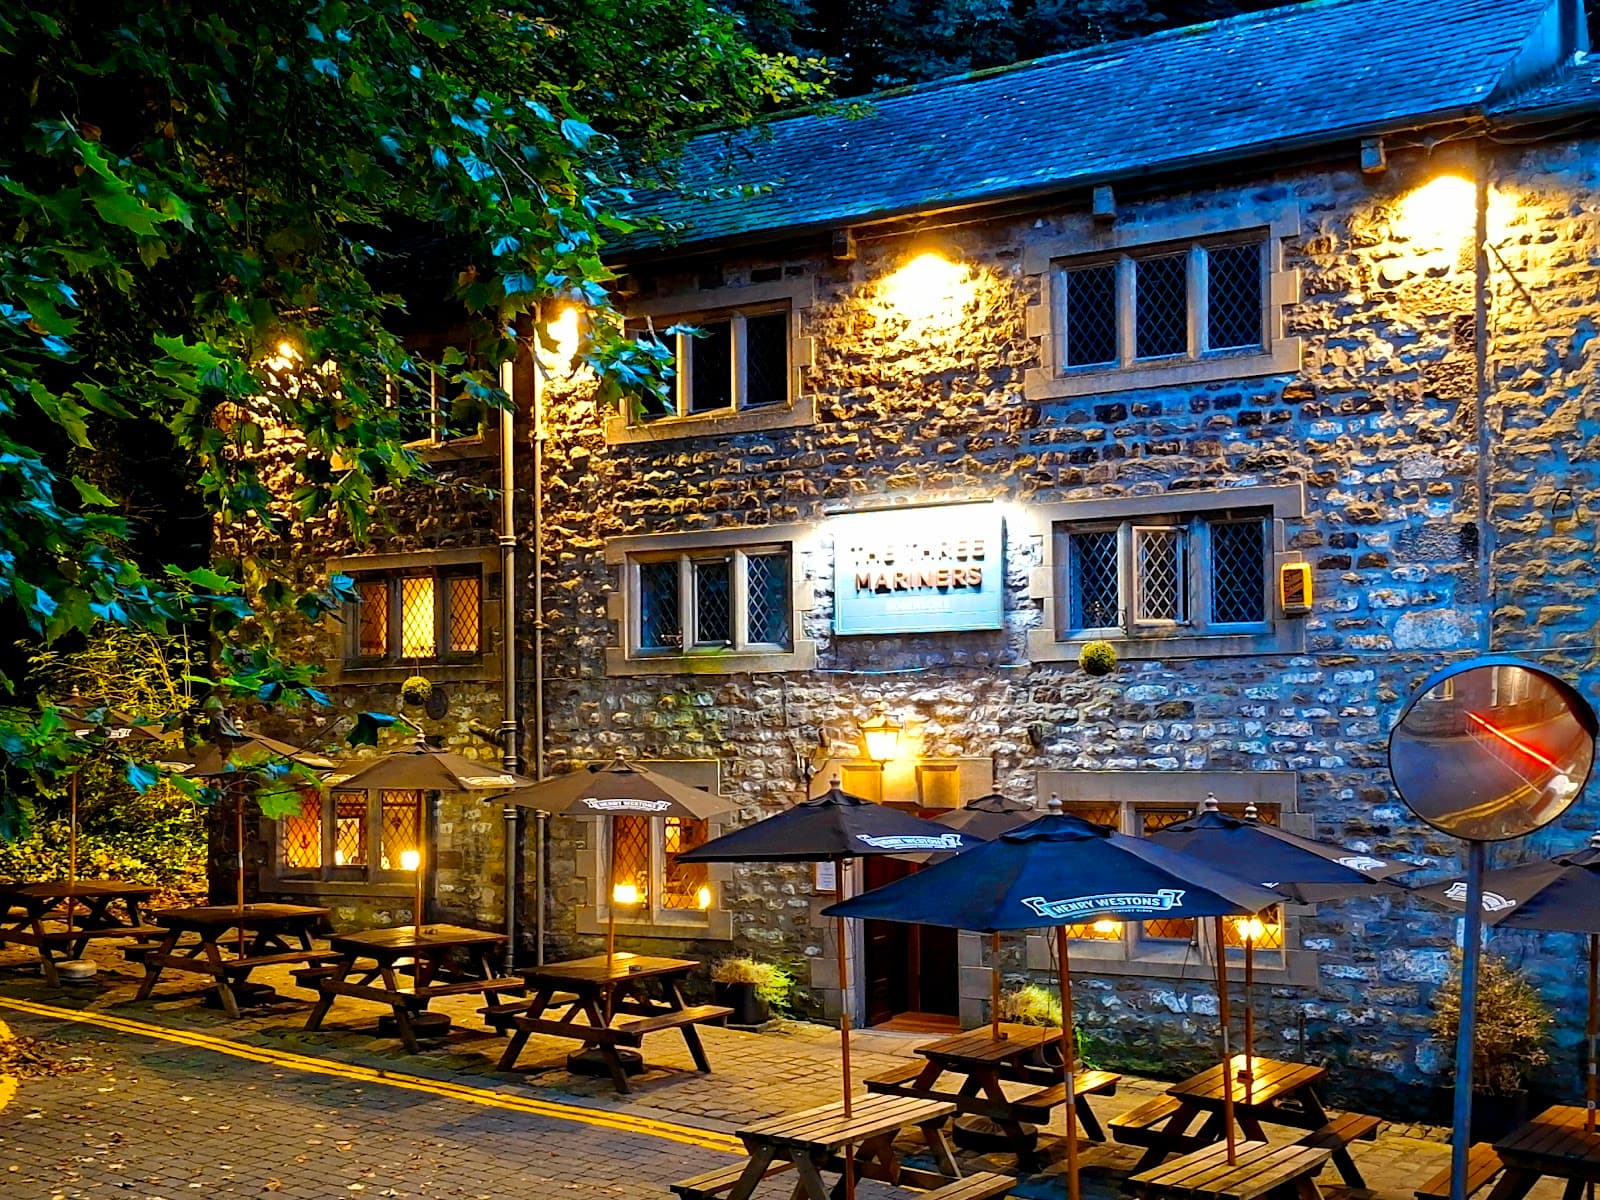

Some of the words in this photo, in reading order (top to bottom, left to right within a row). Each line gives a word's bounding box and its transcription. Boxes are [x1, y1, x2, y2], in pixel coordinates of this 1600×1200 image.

[904, 537, 986, 563] HREE
[856, 567, 982, 593] MARINERS
[1053, 900, 1094, 914] HENRY
[1096, 896, 1161, 907] WESTONS
